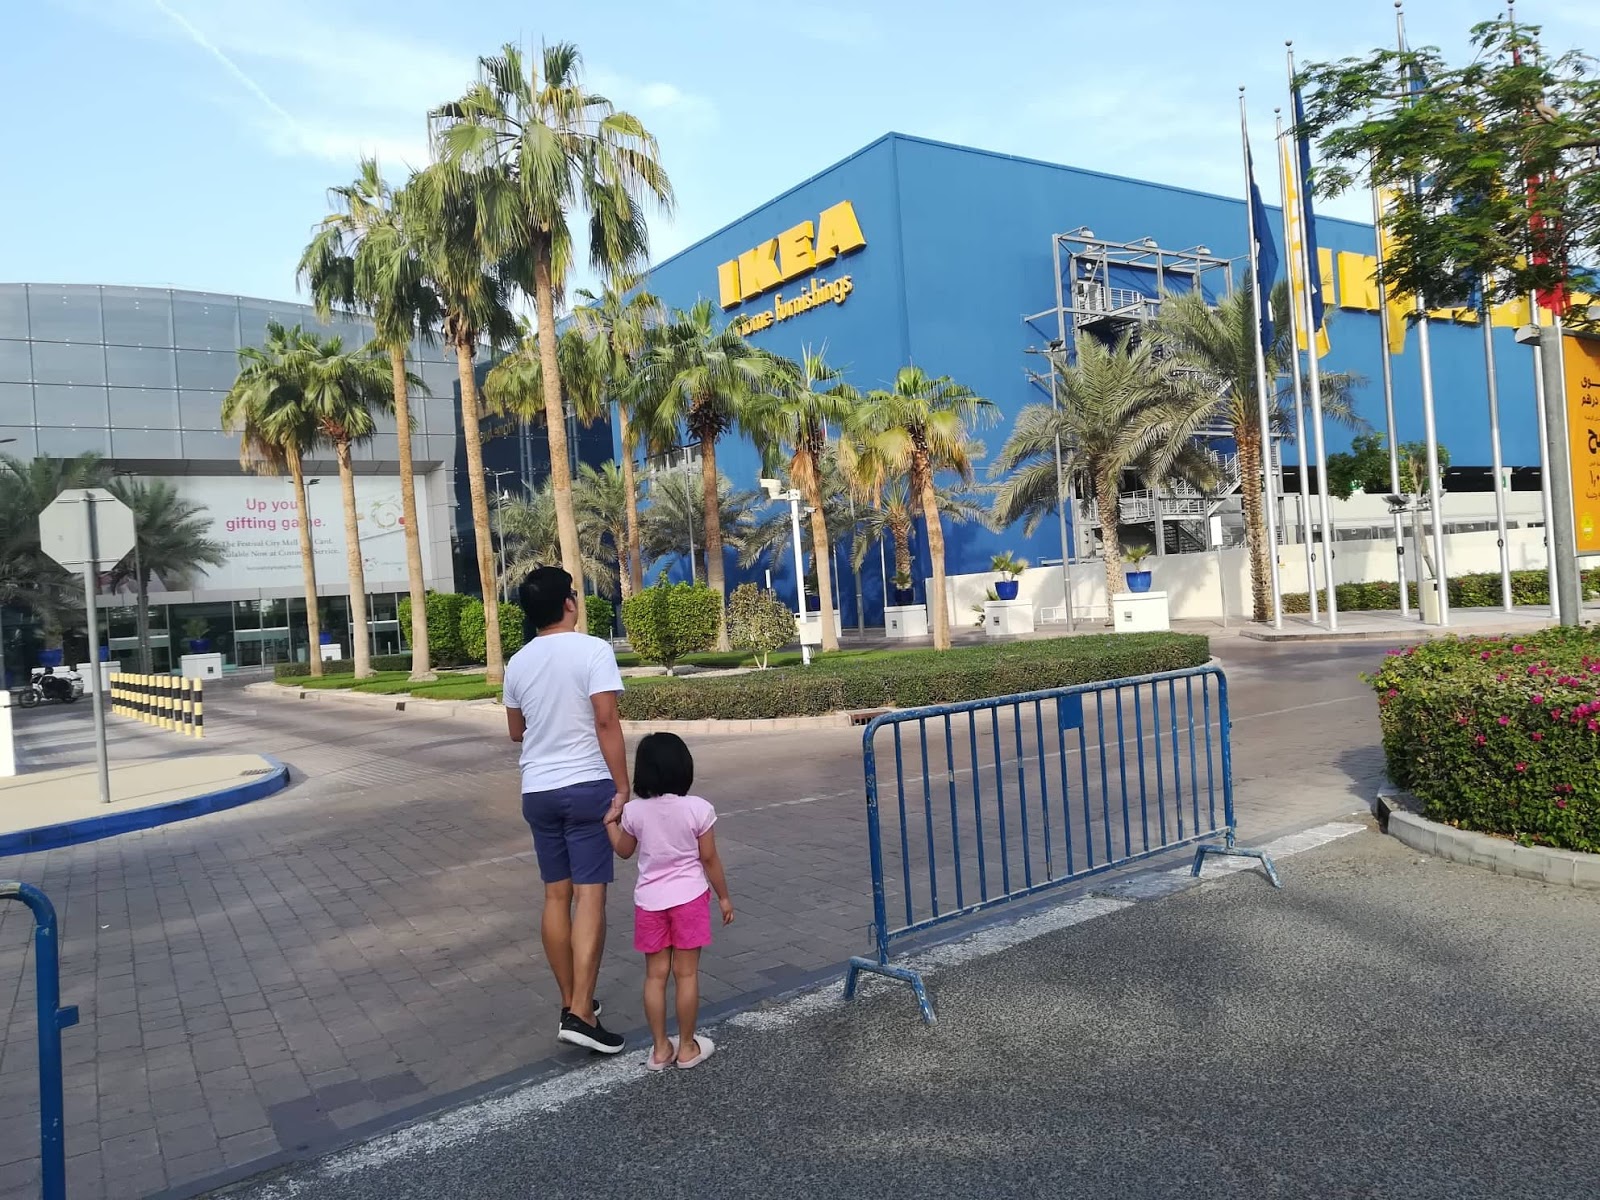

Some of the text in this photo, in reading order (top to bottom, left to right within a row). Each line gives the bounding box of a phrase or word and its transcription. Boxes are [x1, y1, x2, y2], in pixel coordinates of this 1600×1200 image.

[718, 200, 867, 310] IKEA
[775, 274, 853, 321] furnishings
[246, 498, 298, 513] Up you
[226, 517, 326, 532] gifting gae.
[237, 540, 264, 548] Festival
[265, 540, 281, 549] City
[282, 539, 298, 547] Mall
[221, 550, 249, 558] vailable
